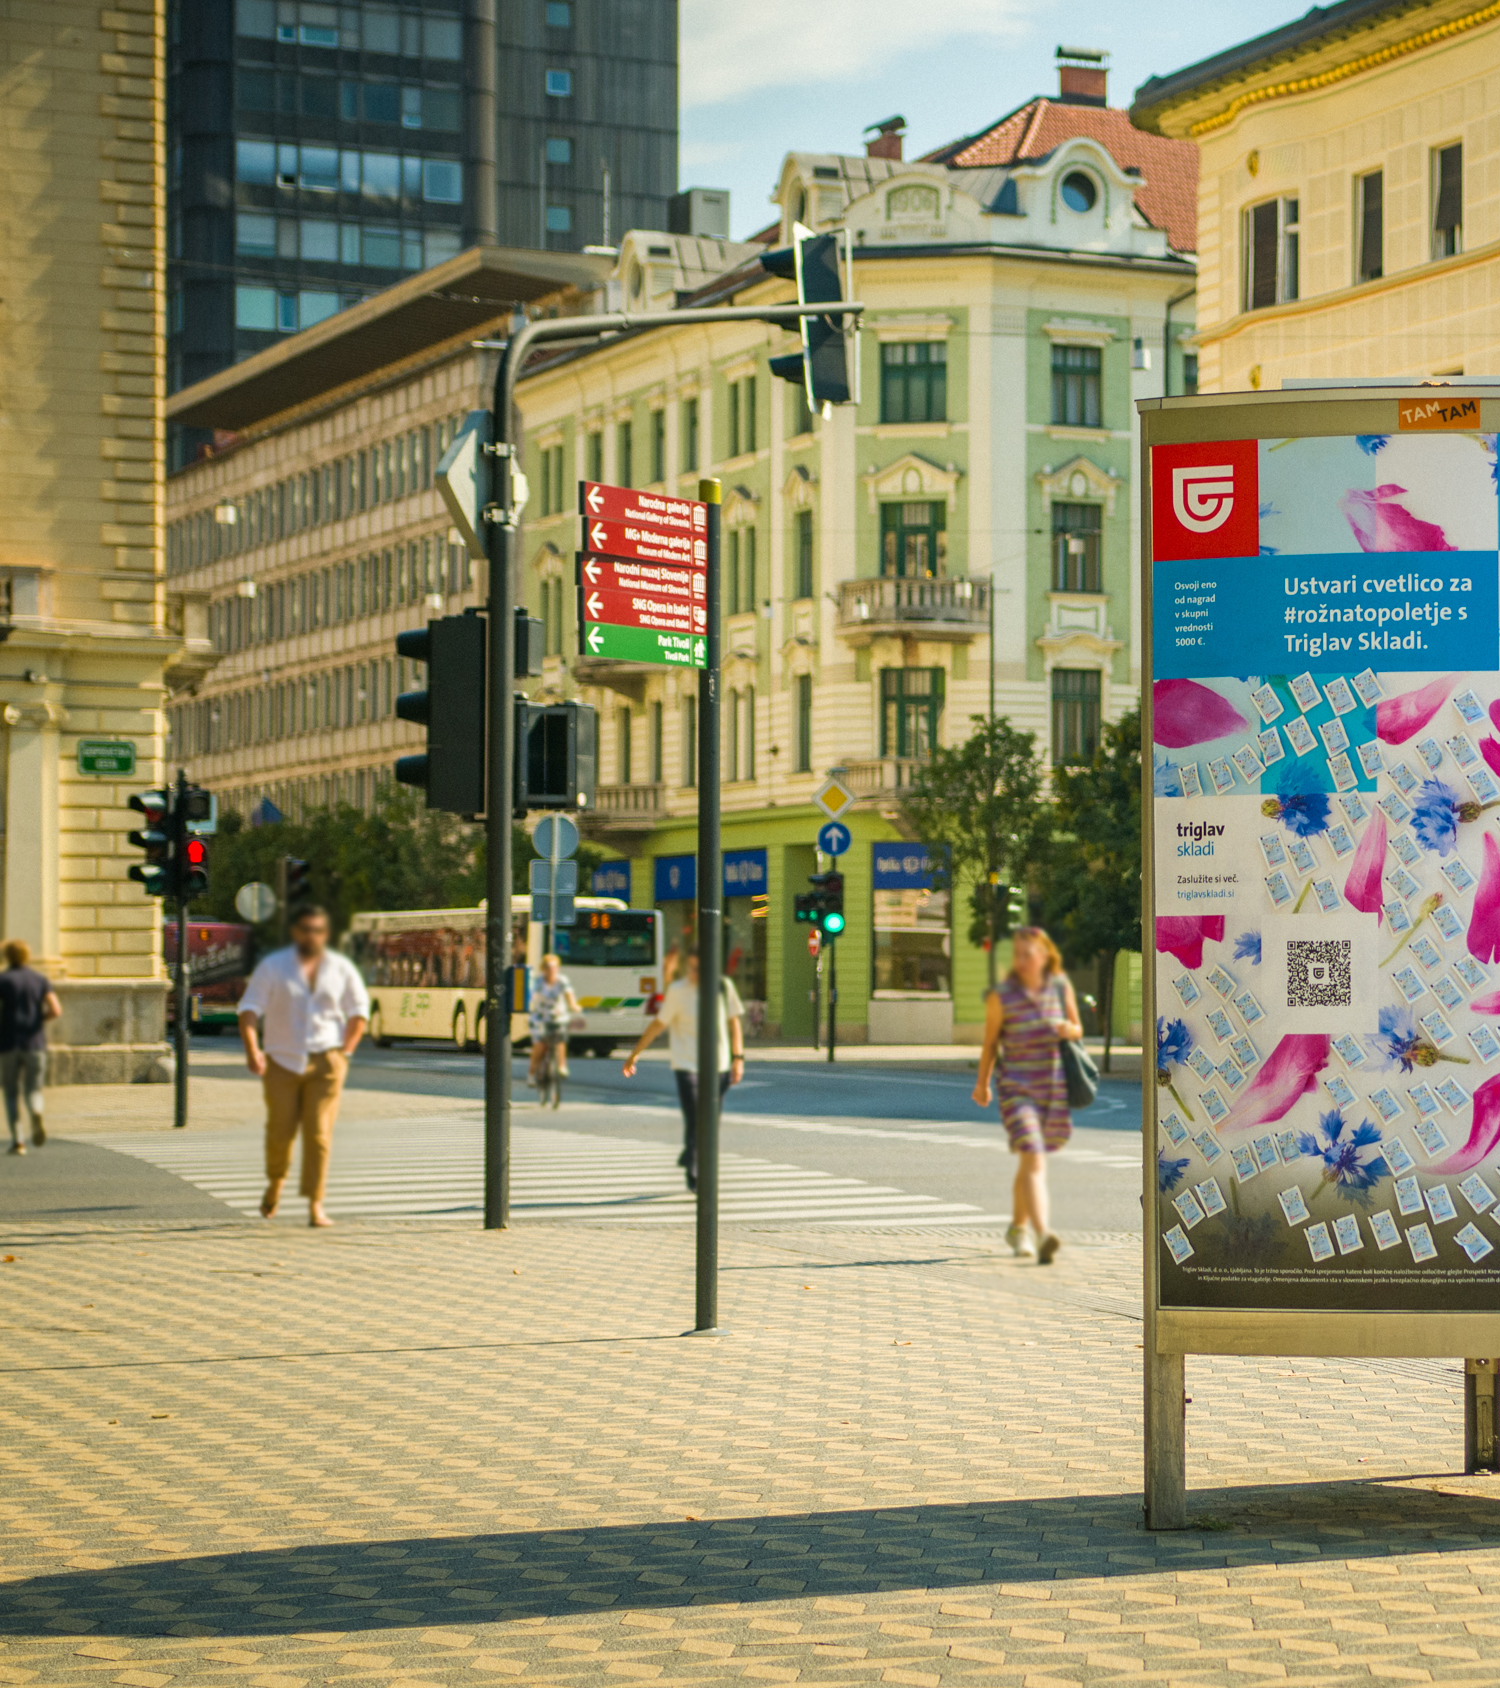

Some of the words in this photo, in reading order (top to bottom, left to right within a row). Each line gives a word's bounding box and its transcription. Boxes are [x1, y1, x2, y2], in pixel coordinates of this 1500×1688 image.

[1402, 401, 1440, 423] TAM
[1438, 401, 1476, 422] TAM
[639, 496, 665, 511] Narodna
[667, 502, 689, 516] galerija
[625, 508, 645, 520] National
[646, 512, 663, 525] Gallery
[664, 516, 669, 524] of
[669, 516, 689, 528] Slovenia
[625, 528, 640, 540] MG+
[642, 530, 668, 546] Moderna
[669, 536, 690, 550] galerija
[637, 545, 657, 557] Museum
[658, 548, 663, 557] of
[663, 549, 681, 560] Modern
[682, 553, 690, 562] Art
[614, 562, 640, 576] Narodni
[641, 567, 660, 581] muzej
[661, 569, 689, 584] Slovenije
[619, 578, 640, 589] National
[641, 581, 662, 592] Museum
[662, 584, 668, 592] of
[668, 585, 688, 596] Slovenia
[1174, 581, 1199, 591] Osvoji
[1284, 574, 1356, 595] Ustvari
[1363, 573, 1443, 593] cvetlico
[1449, 577, 1472, 592] za
[632, 598, 646, 610] SNG
[647, 600, 666, 613] Opera
[667, 603, 672, 613] in
[674, 604, 689, 616] balet
[1175, 596, 1185, 604] od
[1187, 594, 1216, 605] nagrad
[639, 614, 650, 624] SNG
[651, 616, 666, 626] Opera
[666, 618, 675, 627] and
[1182, 609, 1208, 619] skupni
[1284, 602, 1452, 627] #rožnatopoletje
[1458, 606, 1467, 620] s
[1175, 622, 1213, 632] vrednosti
[658, 635, 672, 647] Park
[672, 637, 689, 649] Tivoli
[1176, 638, 1195, 646] 5000
[1198, 637, 1205, 645] €.
[1284, 632, 1352, 657] Triglav
[1358, 631, 1428, 650] Skladi.
[664, 651, 677, 660] Tivoli
[678, 653, 689, 662] Park
[1177, 821, 1225, 841] triglav
[1177, 841, 1214, 856] skladi
[1177, 875, 1213, 883] Zaslužite
[1223, 874, 1239, 882] več.
[1177, 889, 1234, 901] triglavskladi.si
